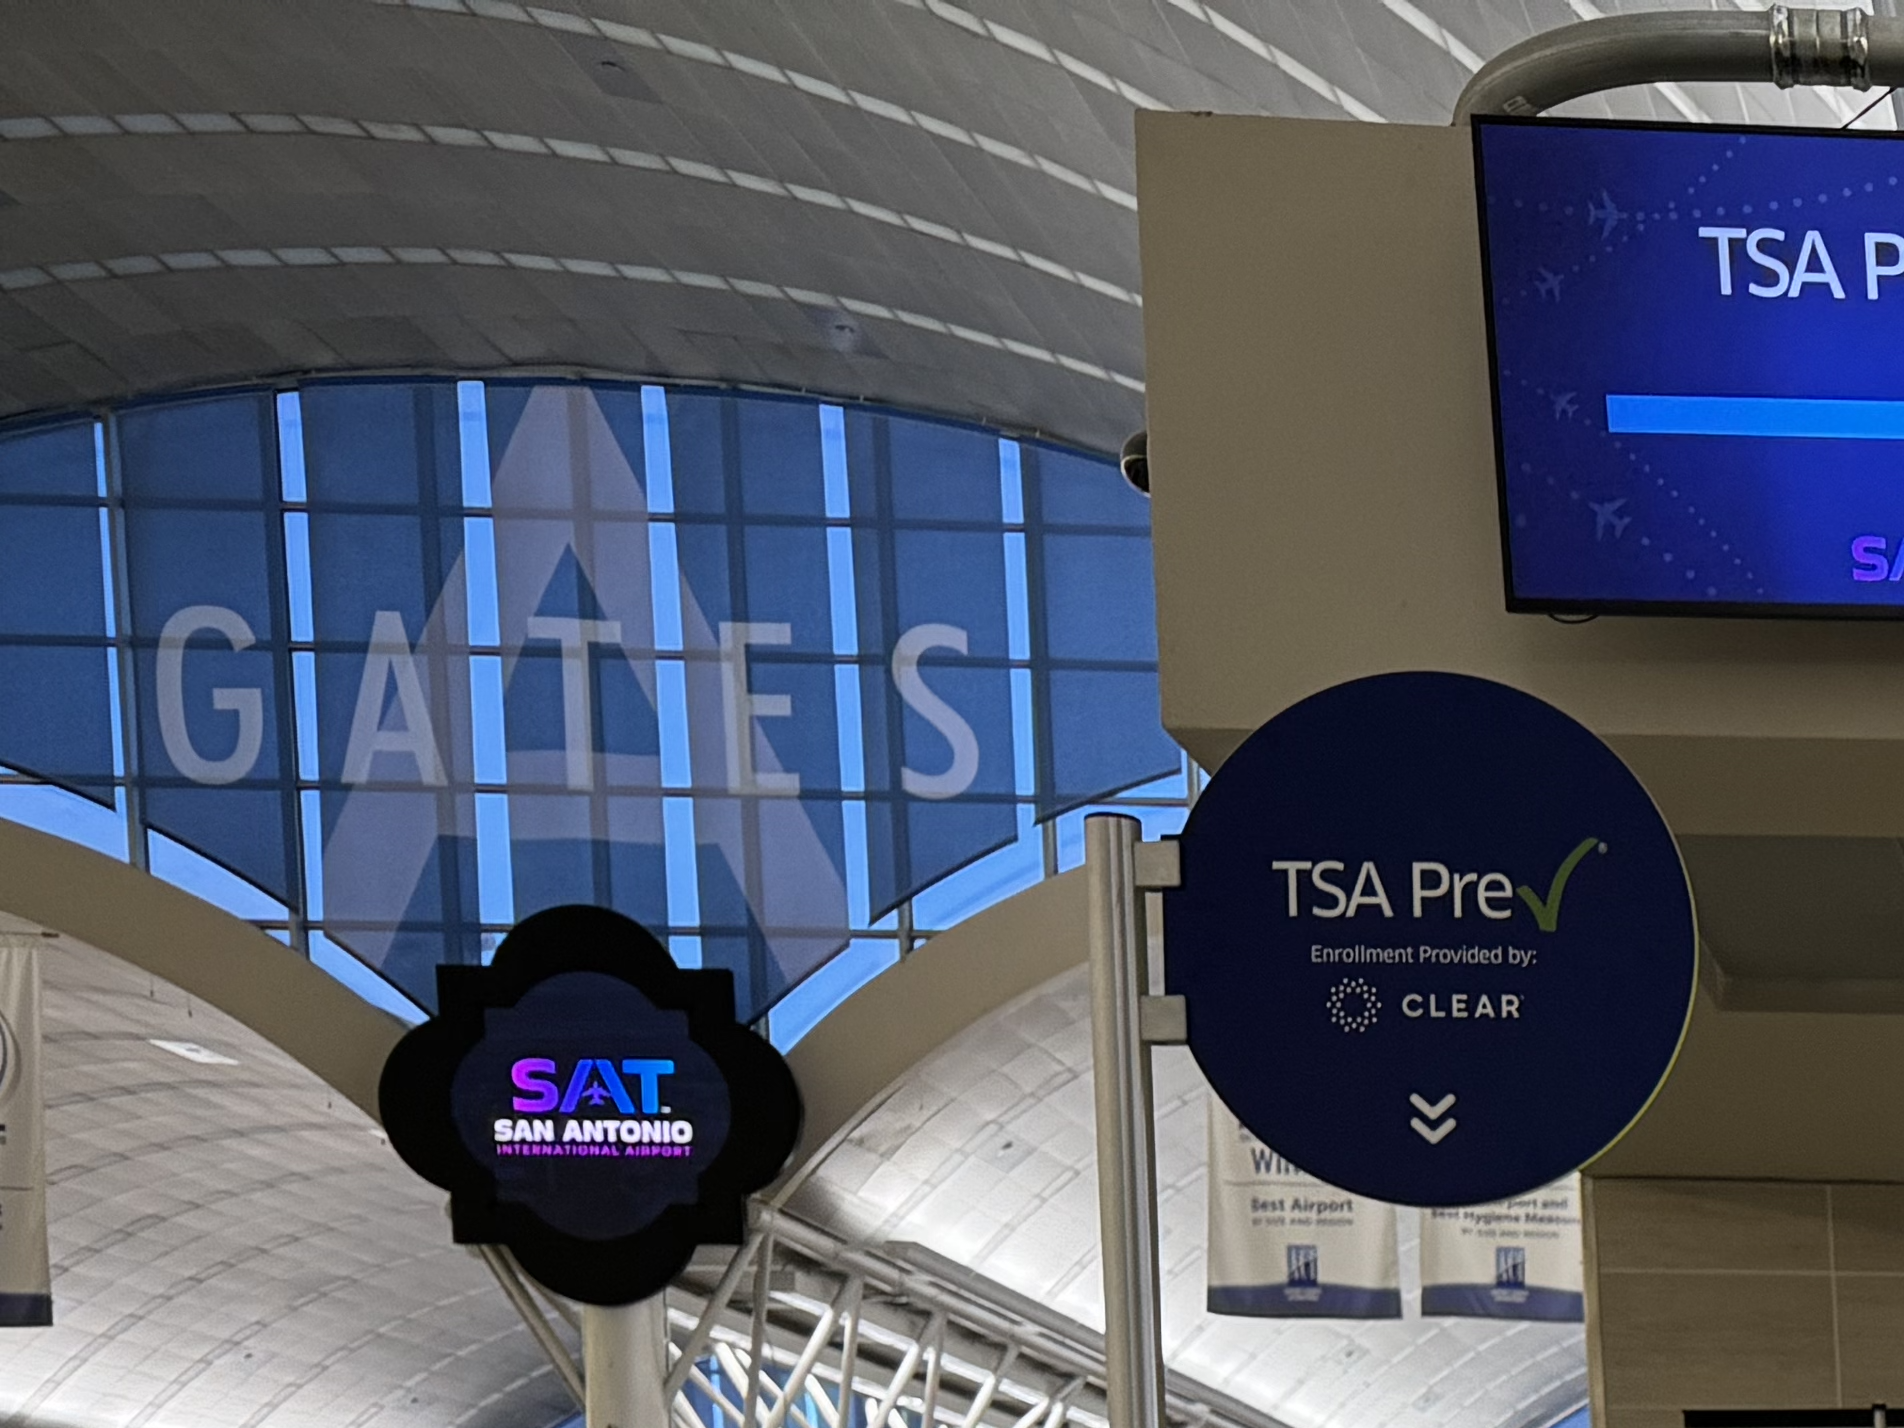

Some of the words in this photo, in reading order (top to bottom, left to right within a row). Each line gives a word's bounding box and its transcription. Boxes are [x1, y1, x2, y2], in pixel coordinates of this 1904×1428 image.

[1698, 226, 1845, 300] TSA
[155, 604, 981, 799] GATES
[1272, 861, 1393, 918] TSA
[1311, 945, 1413, 964] Enrollment
[1419, 946, 1502, 965] Provided
[1508, 946, 1537, 968] by:
[1402, 994, 1521, 1019] CLEAR
[511, 1057, 675, 1114] SAT
[494, 1118, 555, 1142] SAN
[562, 1119, 694, 1144] ANTONIO
[496, 1144, 620, 1156] INTERNATIONAL
[625, 1145, 693, 1157] AIRPORT
[1251, 1196, 1286, 1213] Best
[1292, 1197, 1353, 1216] Airport
